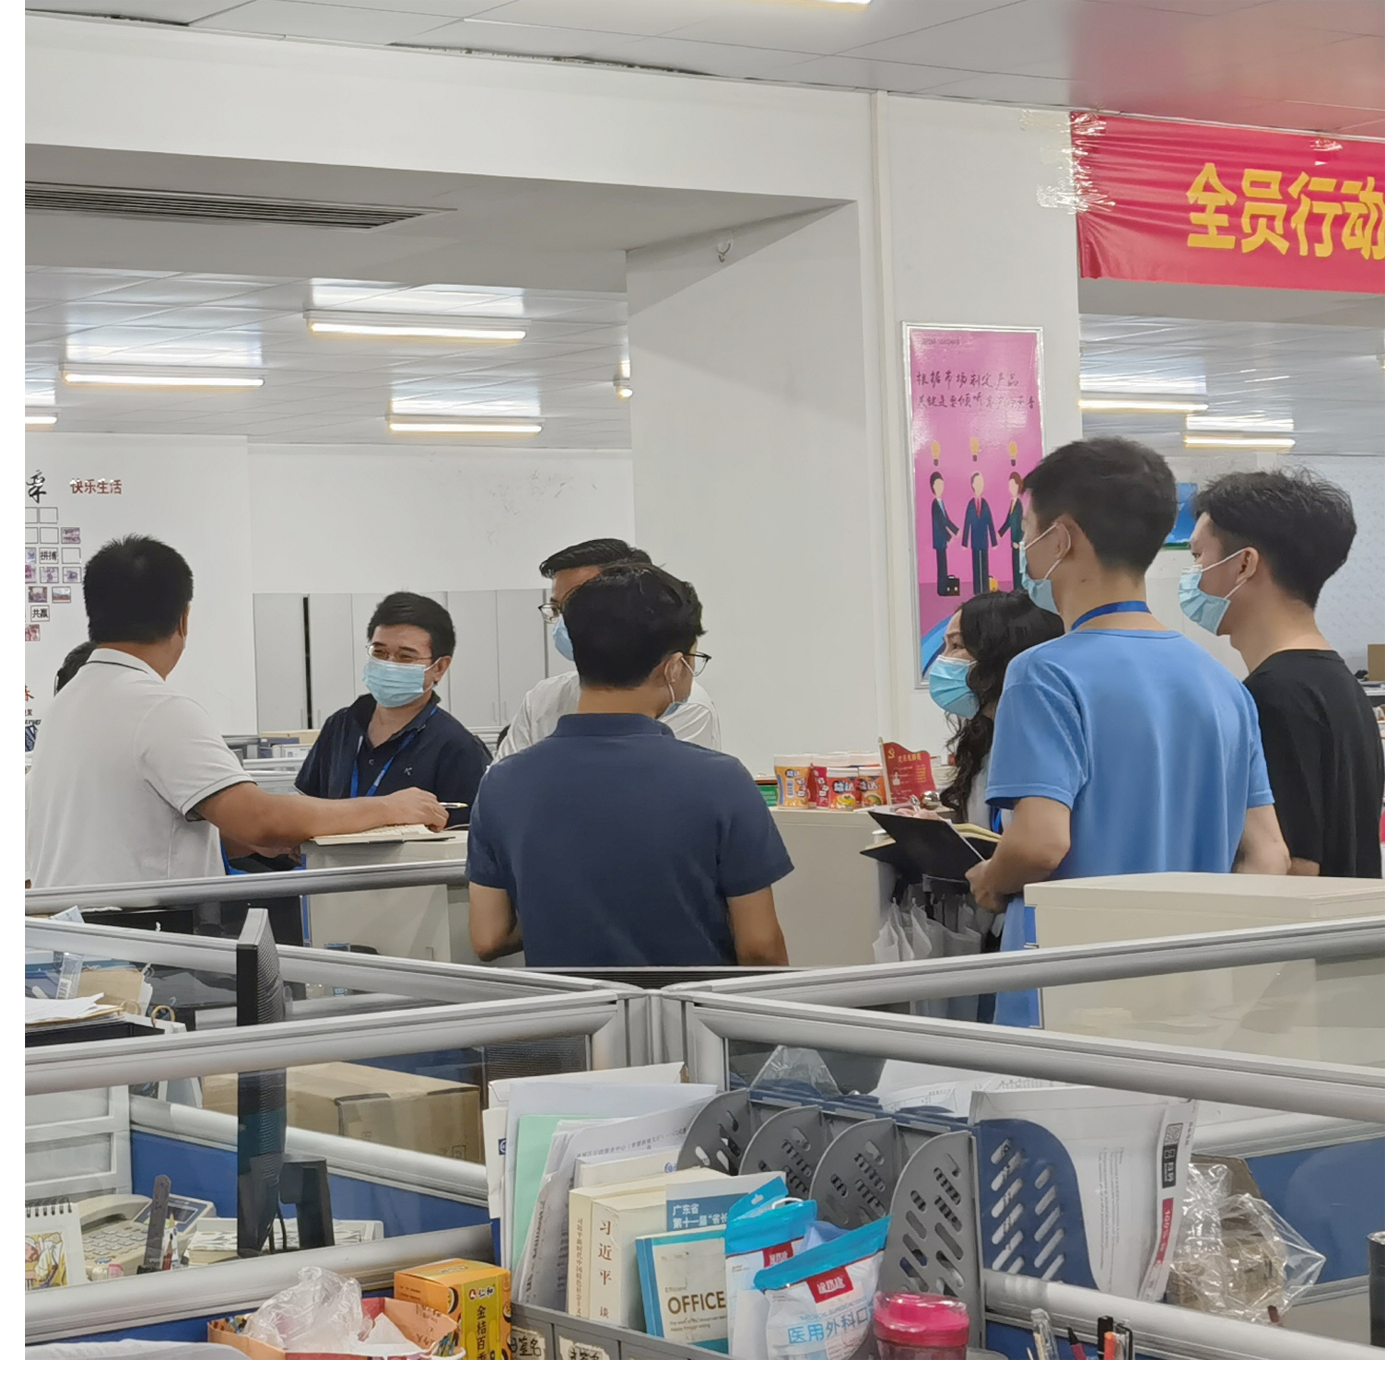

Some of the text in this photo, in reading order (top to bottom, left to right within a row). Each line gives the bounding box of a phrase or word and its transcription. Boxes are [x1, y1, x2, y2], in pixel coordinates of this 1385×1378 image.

[1185, 161, 1385, 261] 全员行动
[70, 478, 122, 495] 快乐生活
[31, 607, 48, 618] 共赢
[672, 1203, 699, 1216] 广东省
[477, 1286, 496, 1298] 仁和
[668, 1291, 727, 1315] OFFICE
[788, 1303, 873, 1344] 医用外科口
